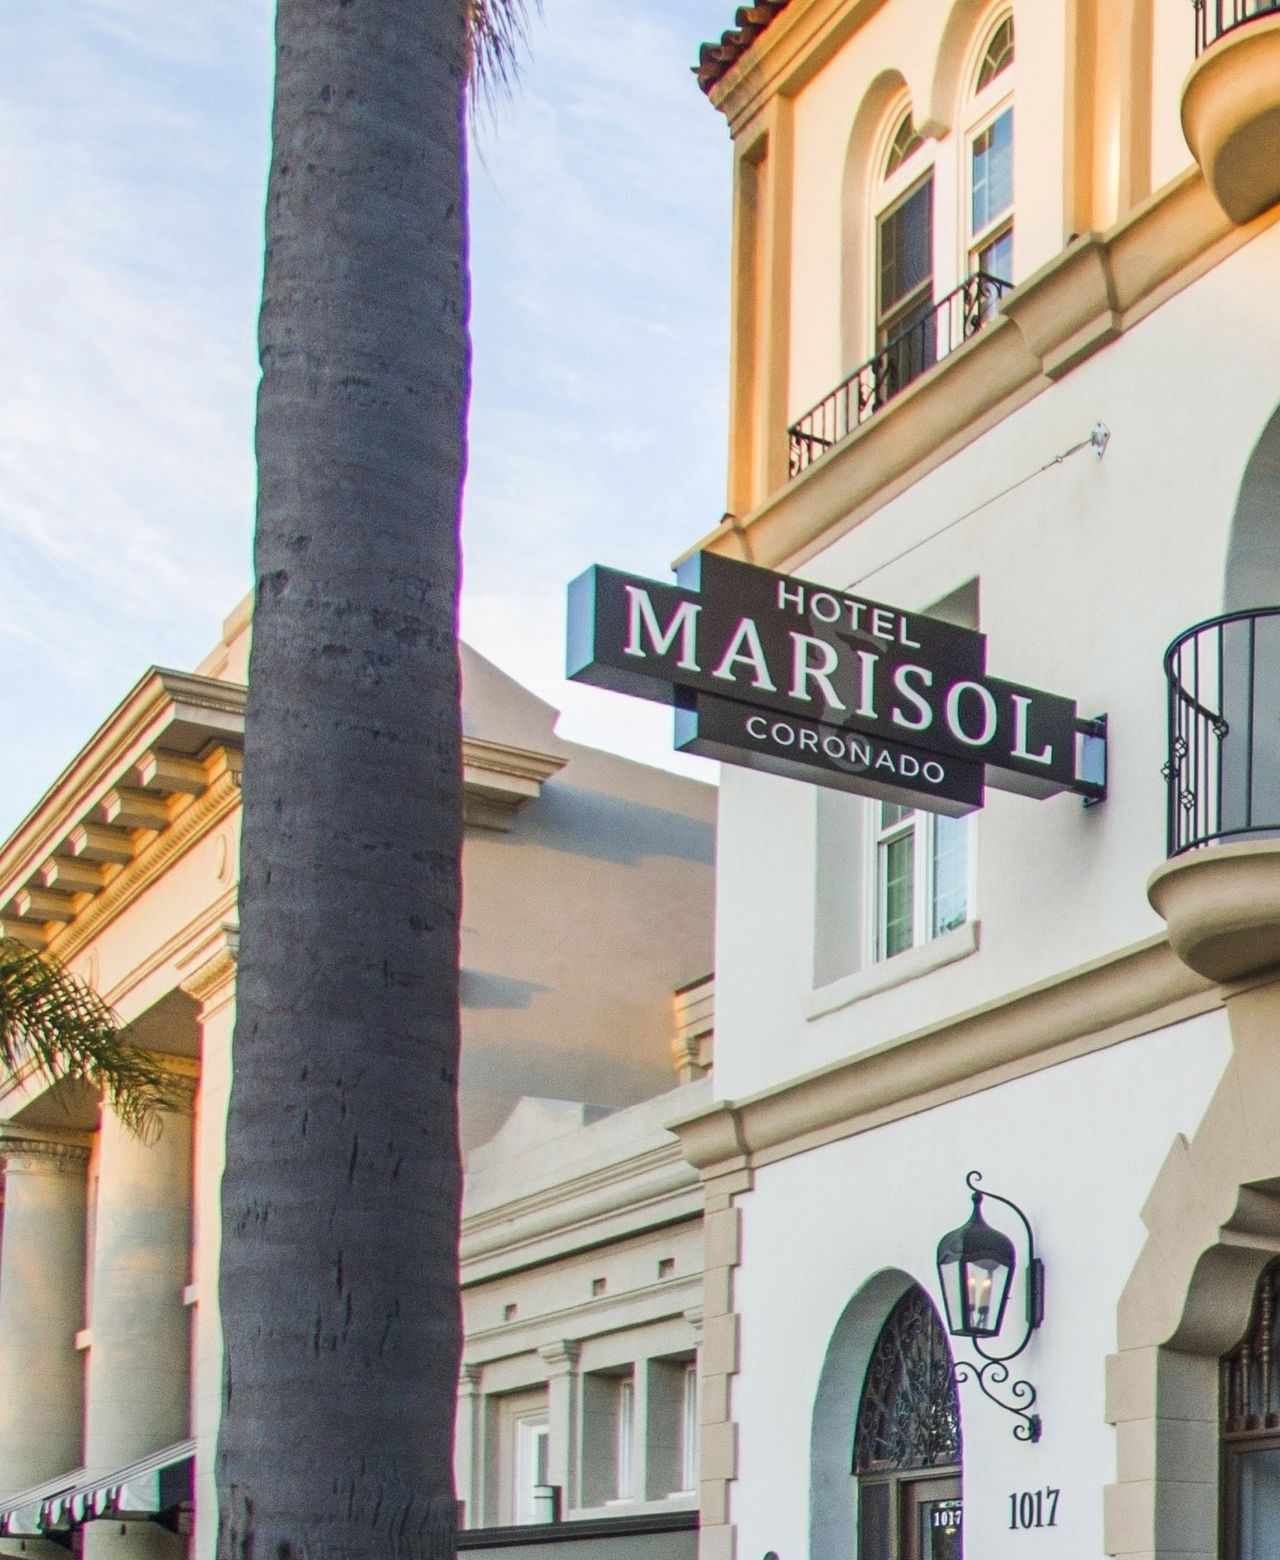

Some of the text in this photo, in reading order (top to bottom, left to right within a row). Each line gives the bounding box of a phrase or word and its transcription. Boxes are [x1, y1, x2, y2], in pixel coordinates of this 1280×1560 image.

[777, 580, 921, 648] HOTEL
[622, 585, 1053, 766] MARISOL
[745, 717, 945, 784] CORONADO
[934, 1510, 962, 1527] 1017
[1008, 1485, 1060, 1530] 1017
